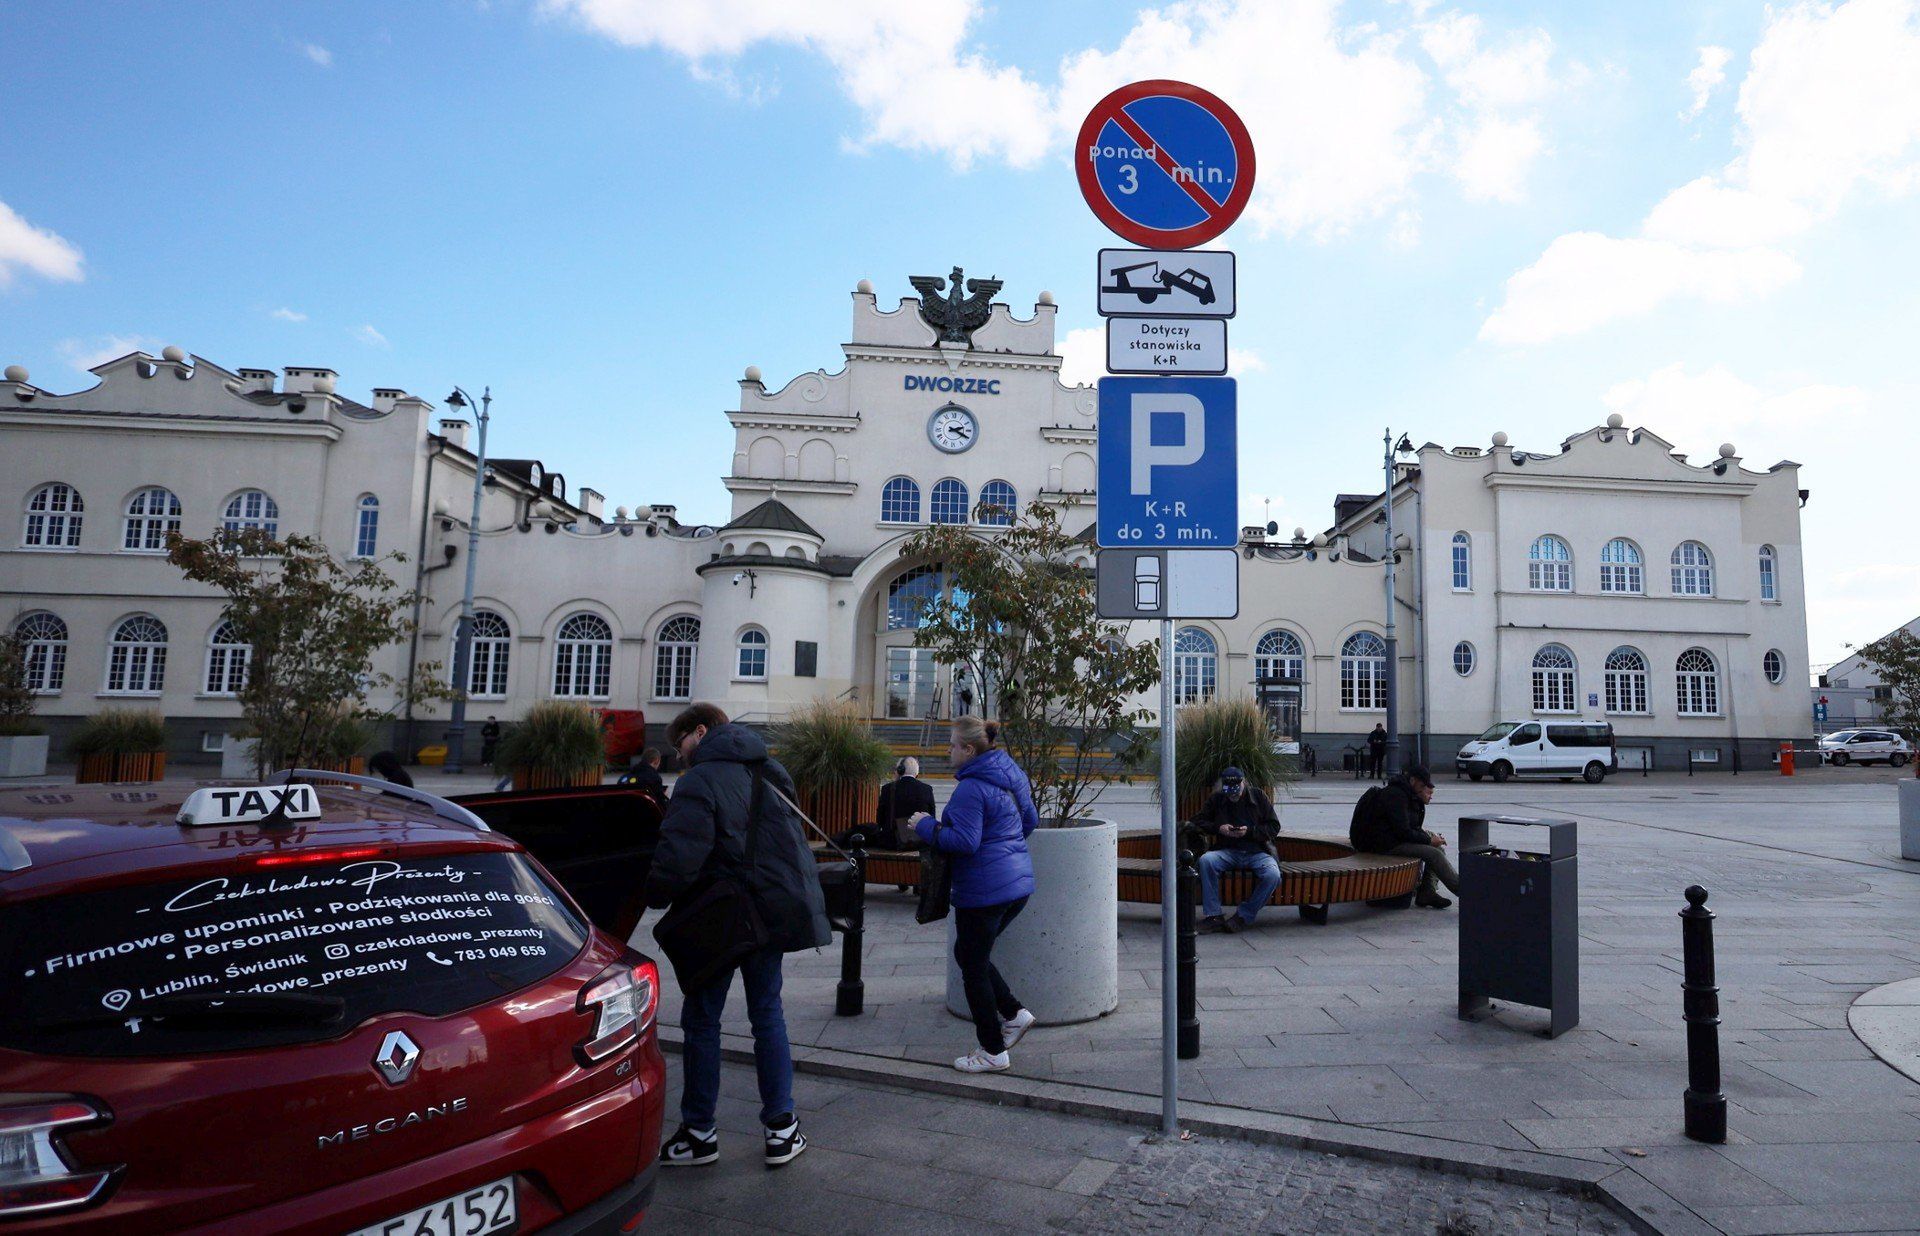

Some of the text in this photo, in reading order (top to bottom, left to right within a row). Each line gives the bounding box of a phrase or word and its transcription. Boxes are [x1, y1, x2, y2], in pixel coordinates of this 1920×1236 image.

[1089, 144, 1157, 161] ponad
[1117, 160, 1232, 195] 3 min.
[1141, 323, 1190, 338] Dotyczy
[1129, 340, 1201, 351] stanowiska
[1153, 354, 1178, 366] K+R
[904, 375, 1000, 395] DWORZEC
[1131, 393, 1205, 495] P
[1145, 501, 1187, 518] K+R
[1117, 524, 1218, 540] do 3 min.
[212, 788, 309, 817] TAXI
[164, 860, 466, 912] Czekoladowe Prezenty
[46, 891, 555, 974] Firmowe upominki Podziękowania dla gości
[184, 906, 493, 960] Personalizowane słodkości
[354, 928, 544, 953] czekoladowe_prezenty
[455, 946, 547, 963] 783 049 659
[139, 953, 309, 1000] Lublin, Świdnik
[212, 958, 408, 1004] dowe_prezenty
[318, 1096, 468, 1150] MEGANE
